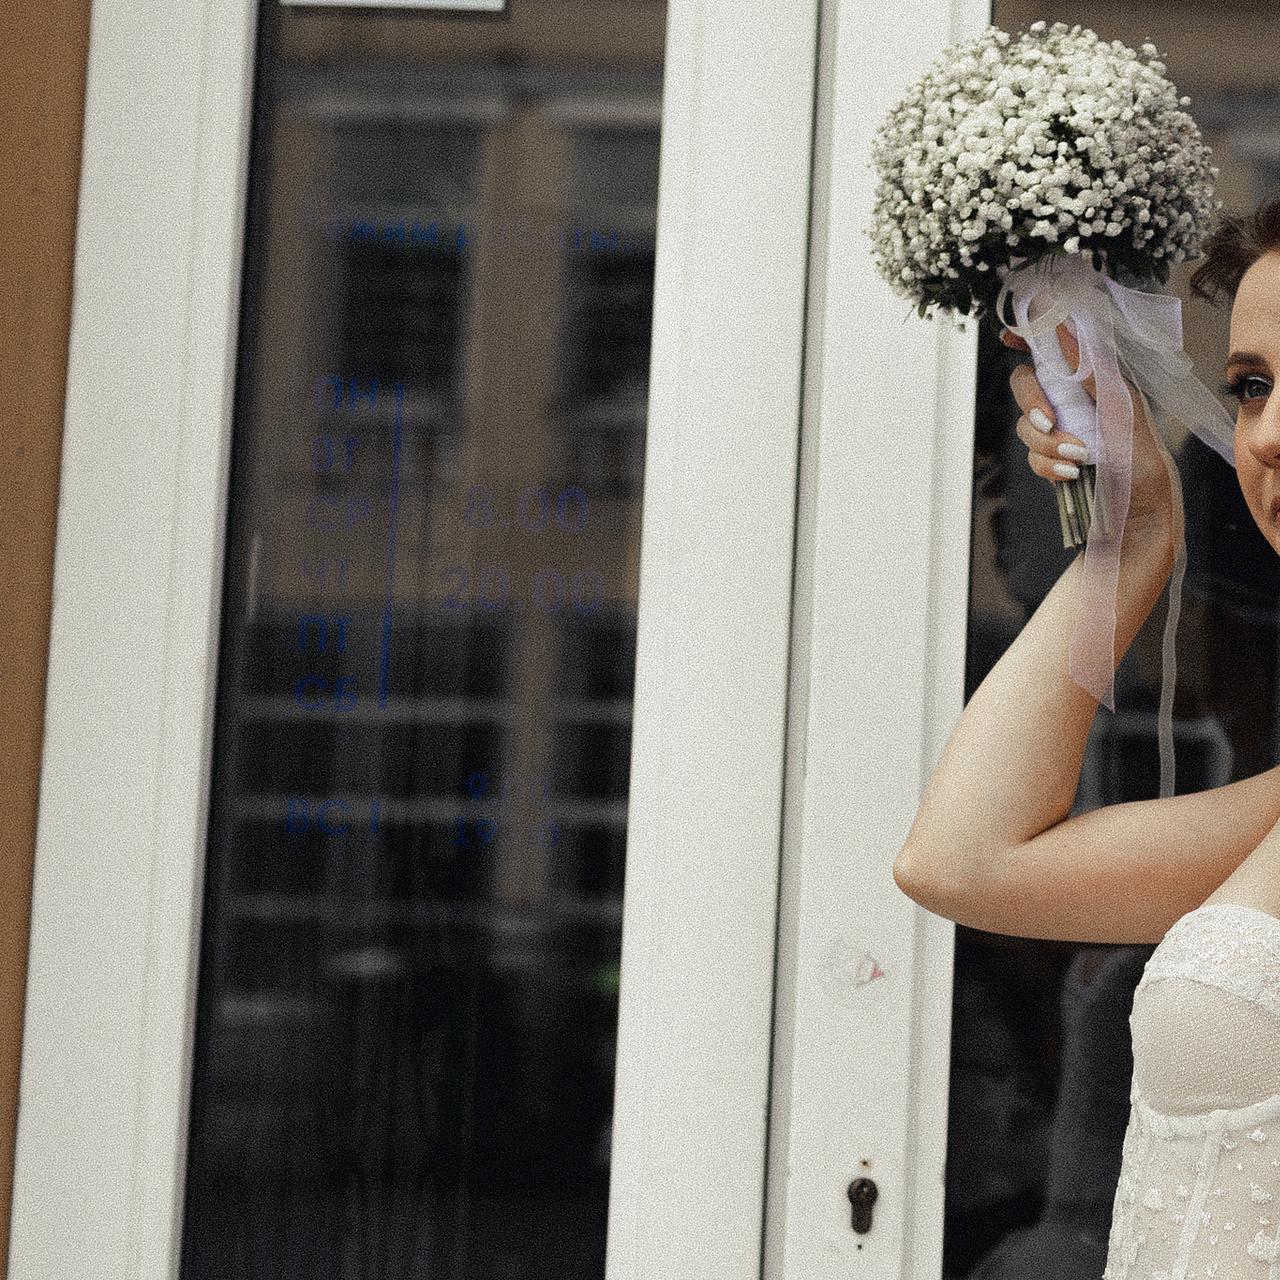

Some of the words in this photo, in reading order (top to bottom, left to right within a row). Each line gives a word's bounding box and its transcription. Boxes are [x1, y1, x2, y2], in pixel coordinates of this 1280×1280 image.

[313, 375, 380, 415] ПН
[309, 436, 362, 472] ВТ
[305, 495, 373, 534] СР
[461, 484, 590, 535] 8.00
[300, 555, 357, 593] ЧТ
[438, 566, 605, 616] 20.00
[296, 614, 354, 652] ПТ
[293, 674, 359, 713] СБ
[284, 797, 351, 837] ВС
